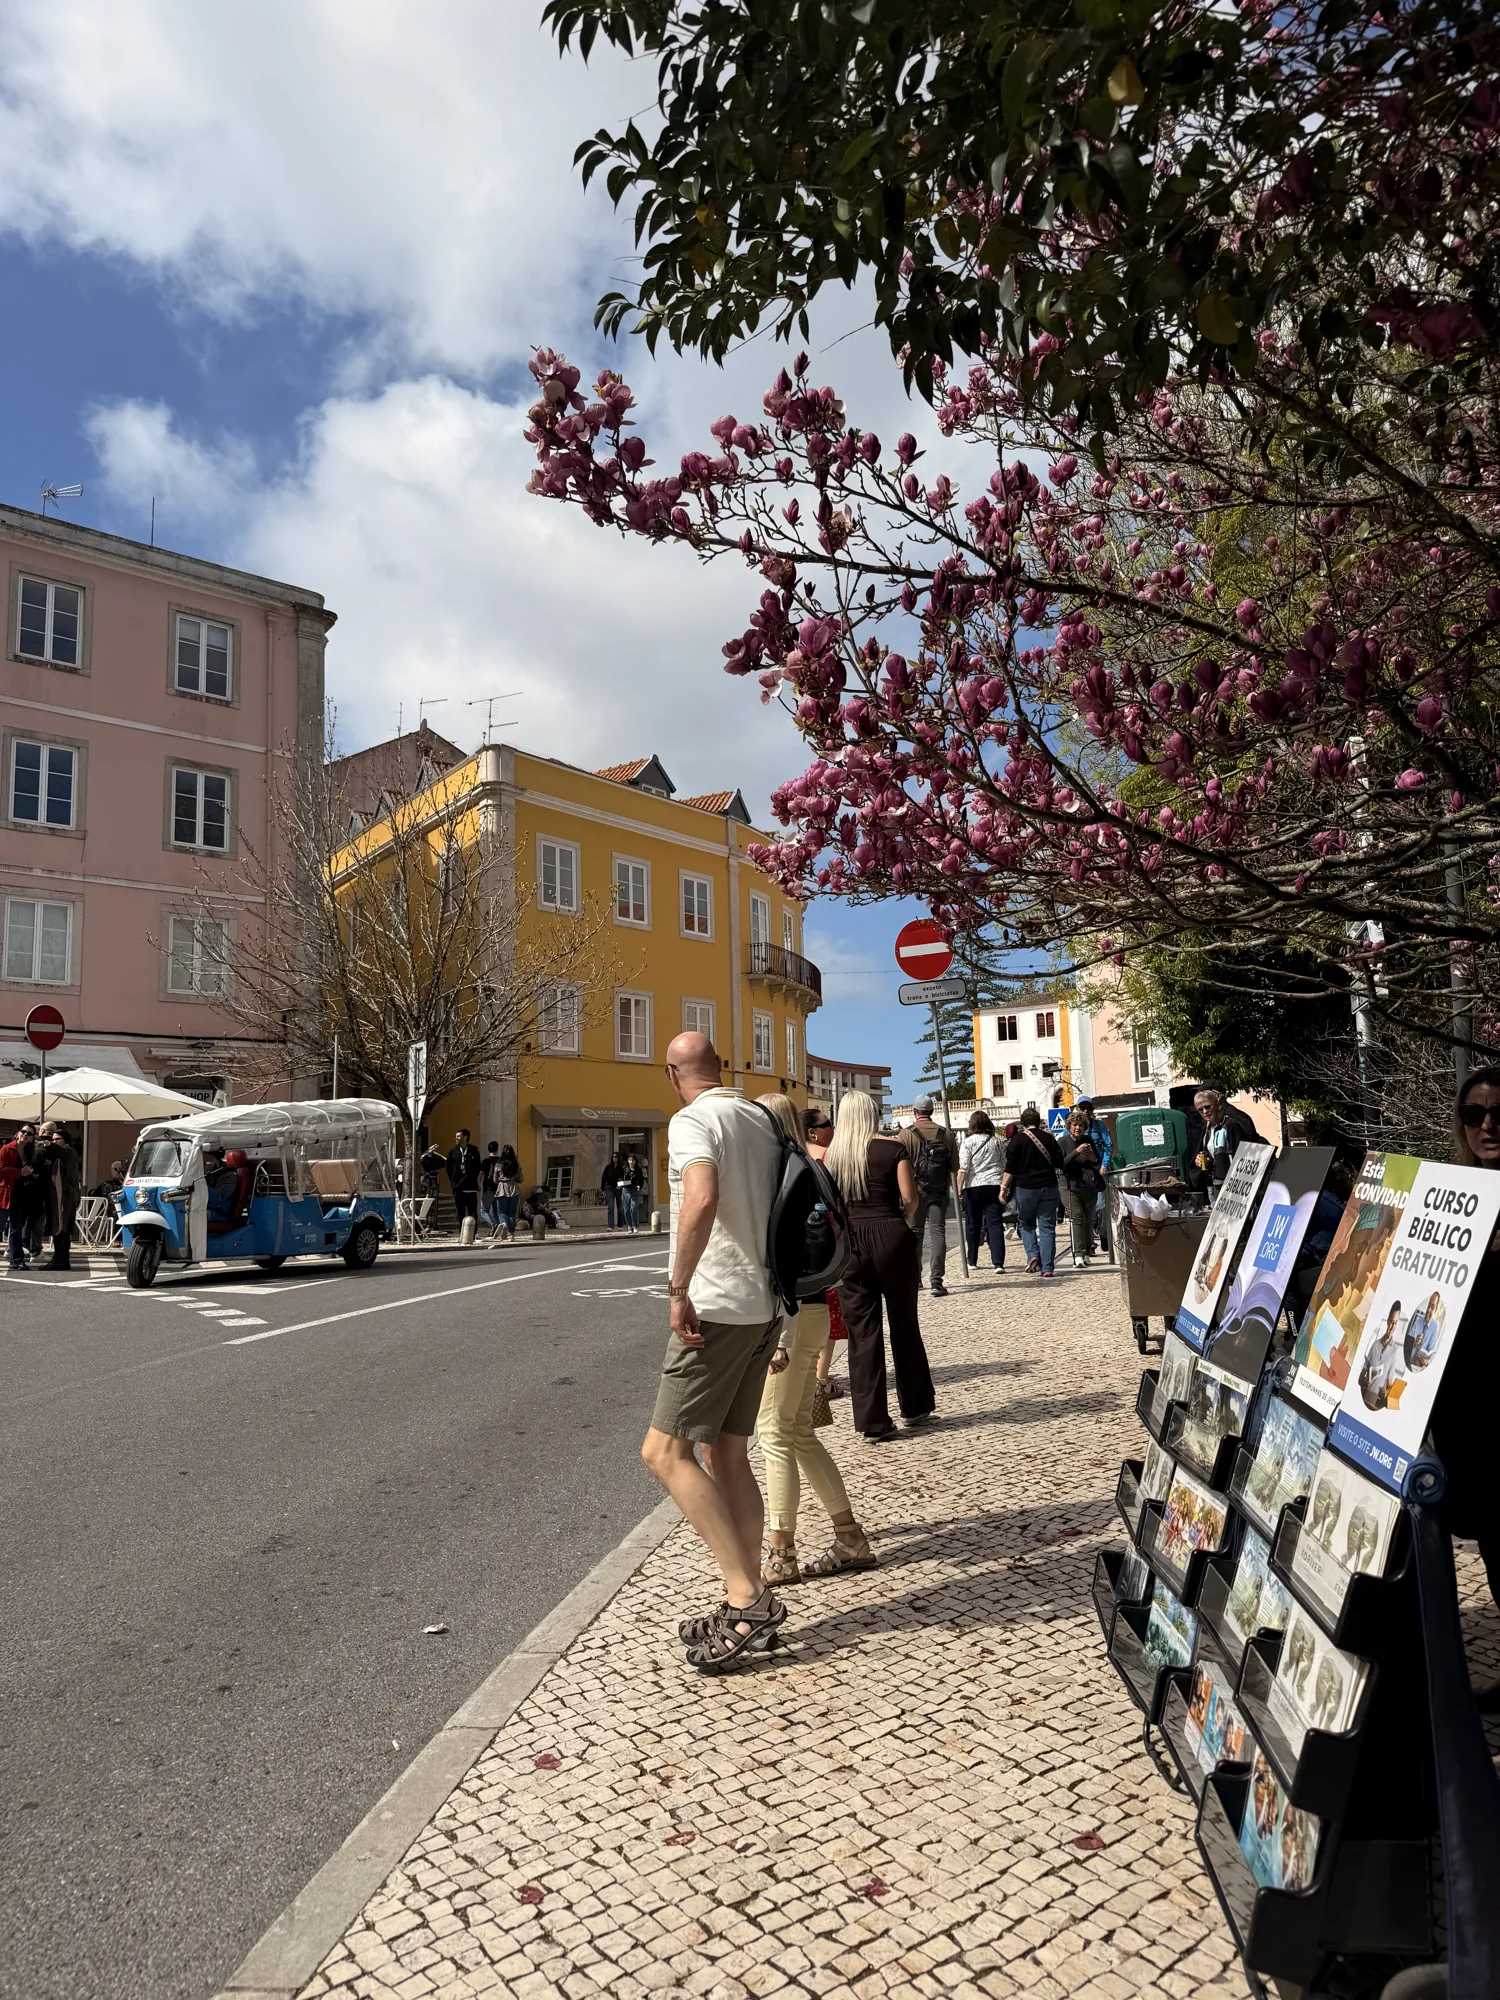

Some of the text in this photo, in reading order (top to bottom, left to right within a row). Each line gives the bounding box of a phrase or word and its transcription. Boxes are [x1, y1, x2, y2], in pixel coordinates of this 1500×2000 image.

[931, 990, 959, 998] bicicletas
[1235, 1158, 1260, 1176] CURSO
[1362, 1160, 1387, 1180] Está
[1226, 1174, 1253, 1198] BÍBLICO
[1354, 1182, 1410, 1209] CONVIDAD
[1215, 1197, 1248, 1219] GRATUITO
[1423, 1187, 1479, 1217] CURSO
[1267, 1214, 1290, 1239] JW
[1407, 1212, 1472, 1252] BÍBLICO
[1259, 1241, 1279, 1260] .ORG
[1391, 1245, 1469, 1288] GRATUITO
[1299, 1376, 1339, 1407] TESTEMUNHAS DE JEOV
[1337, 1423, 1393, 1470] VISITE O SITE JW.ORG
